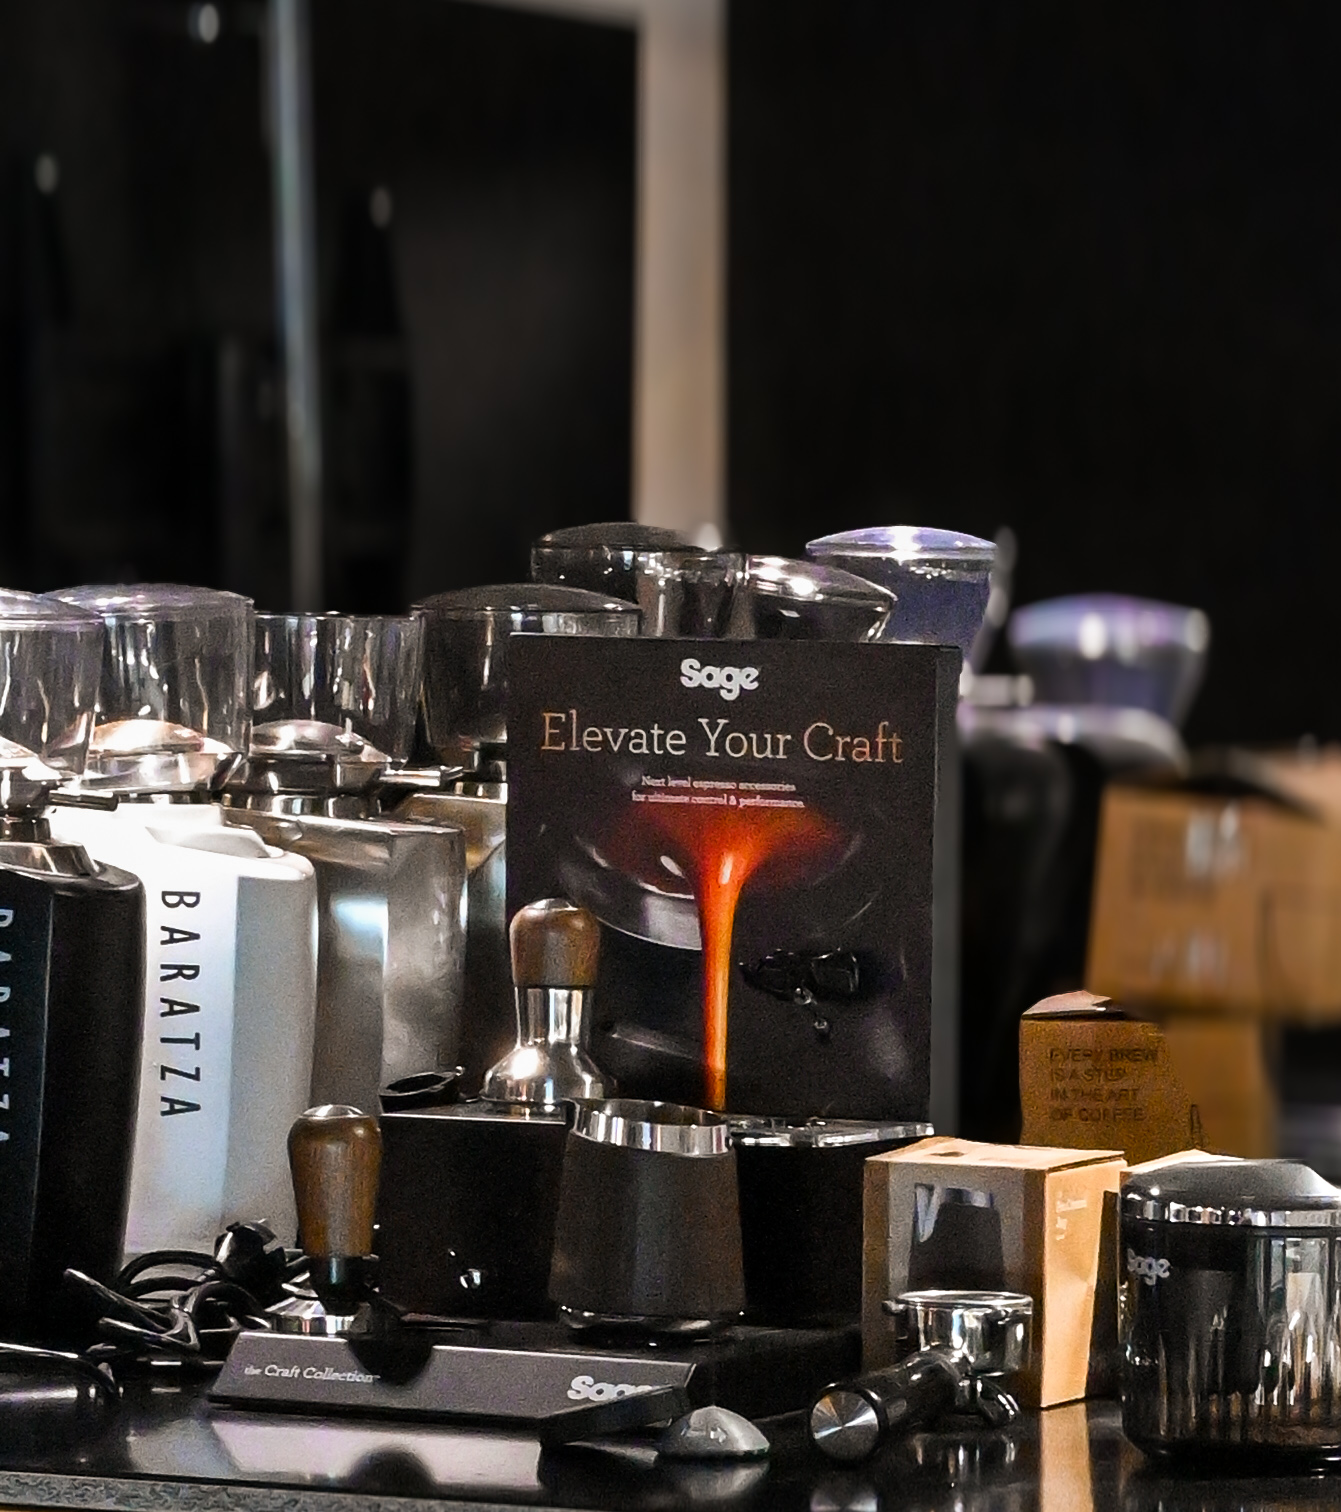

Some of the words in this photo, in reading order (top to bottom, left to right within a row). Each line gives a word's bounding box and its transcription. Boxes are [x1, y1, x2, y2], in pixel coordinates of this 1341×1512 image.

[680, 658, 759, 701] Sage
[541, 709, 687, 756] Elevate
[698, 718, 791, 760] Your
[803, 721, 904, 764] Craft
[159, 890, 201, 1117] BARATZA
[264, 1364, 301, 1378] Craft
[302, 1366, 375, 1383] Collection
